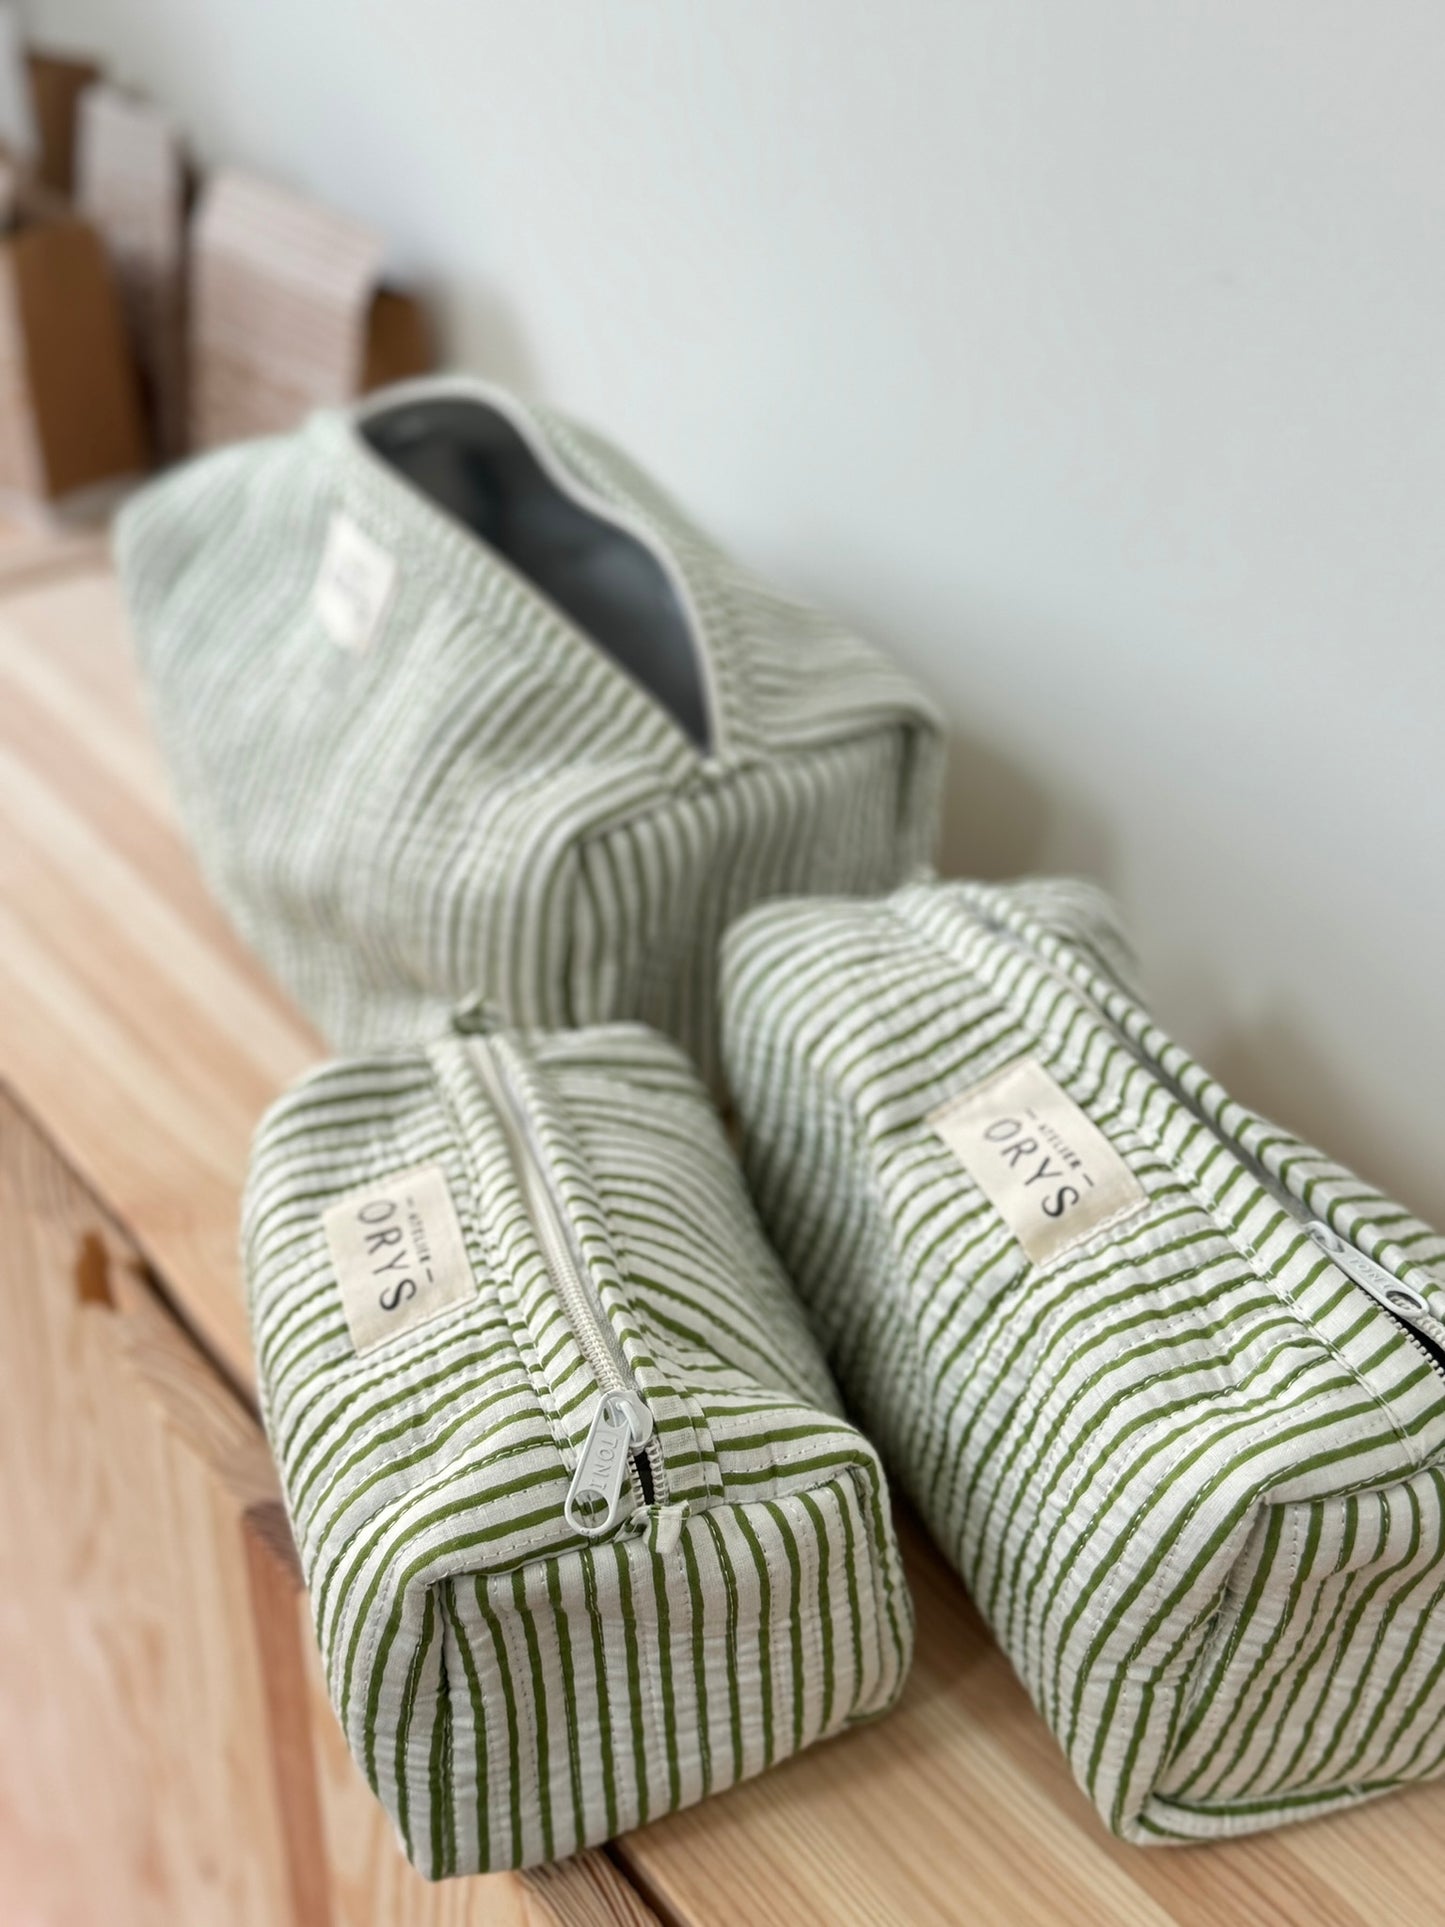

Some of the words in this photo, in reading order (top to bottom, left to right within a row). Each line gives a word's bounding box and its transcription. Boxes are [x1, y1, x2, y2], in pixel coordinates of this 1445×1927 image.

[983, 1117, 1080, 1218] ORYS
[357, 1199, 417, 1312] ORYS
[589, 1438, 619, 1491] TONI
